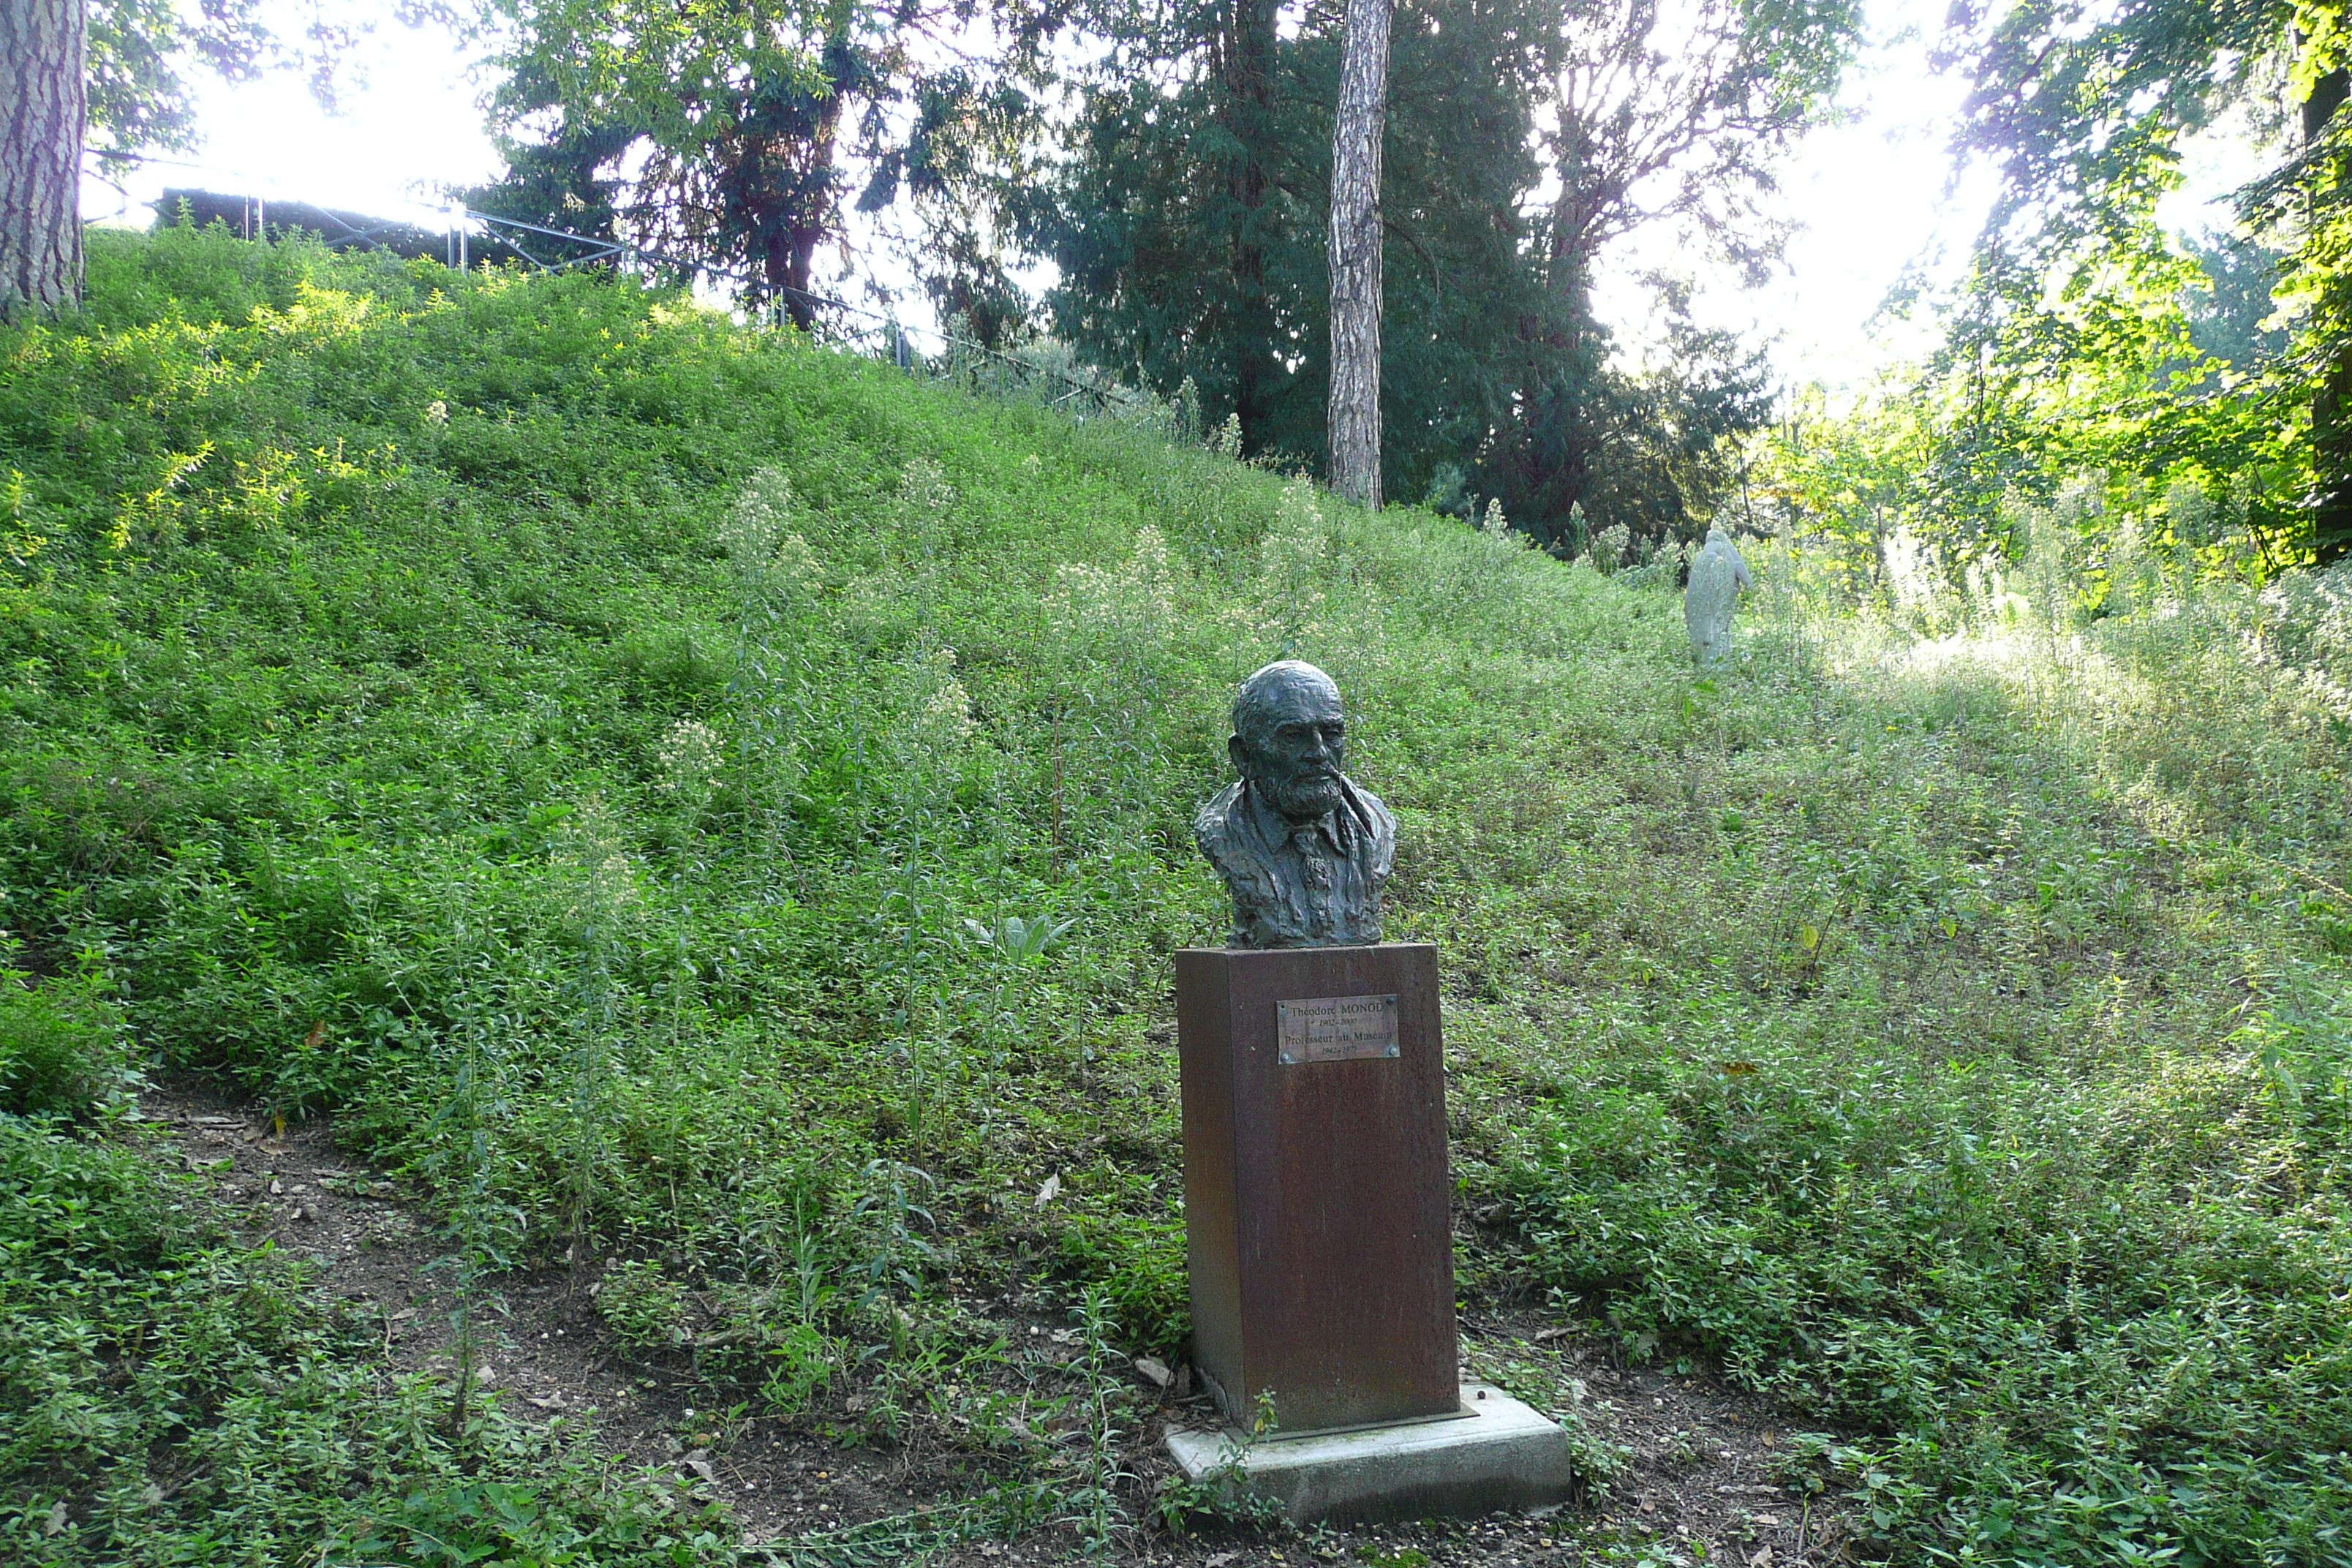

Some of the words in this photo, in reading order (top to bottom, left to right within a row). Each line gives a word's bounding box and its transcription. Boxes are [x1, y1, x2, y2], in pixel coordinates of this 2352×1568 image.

[1291, 1006, 1336, 1017] Théodore
[1341, 1003, 1384, 1014] MONOD
[1285, 1036, 1333, 1045] Professeur
